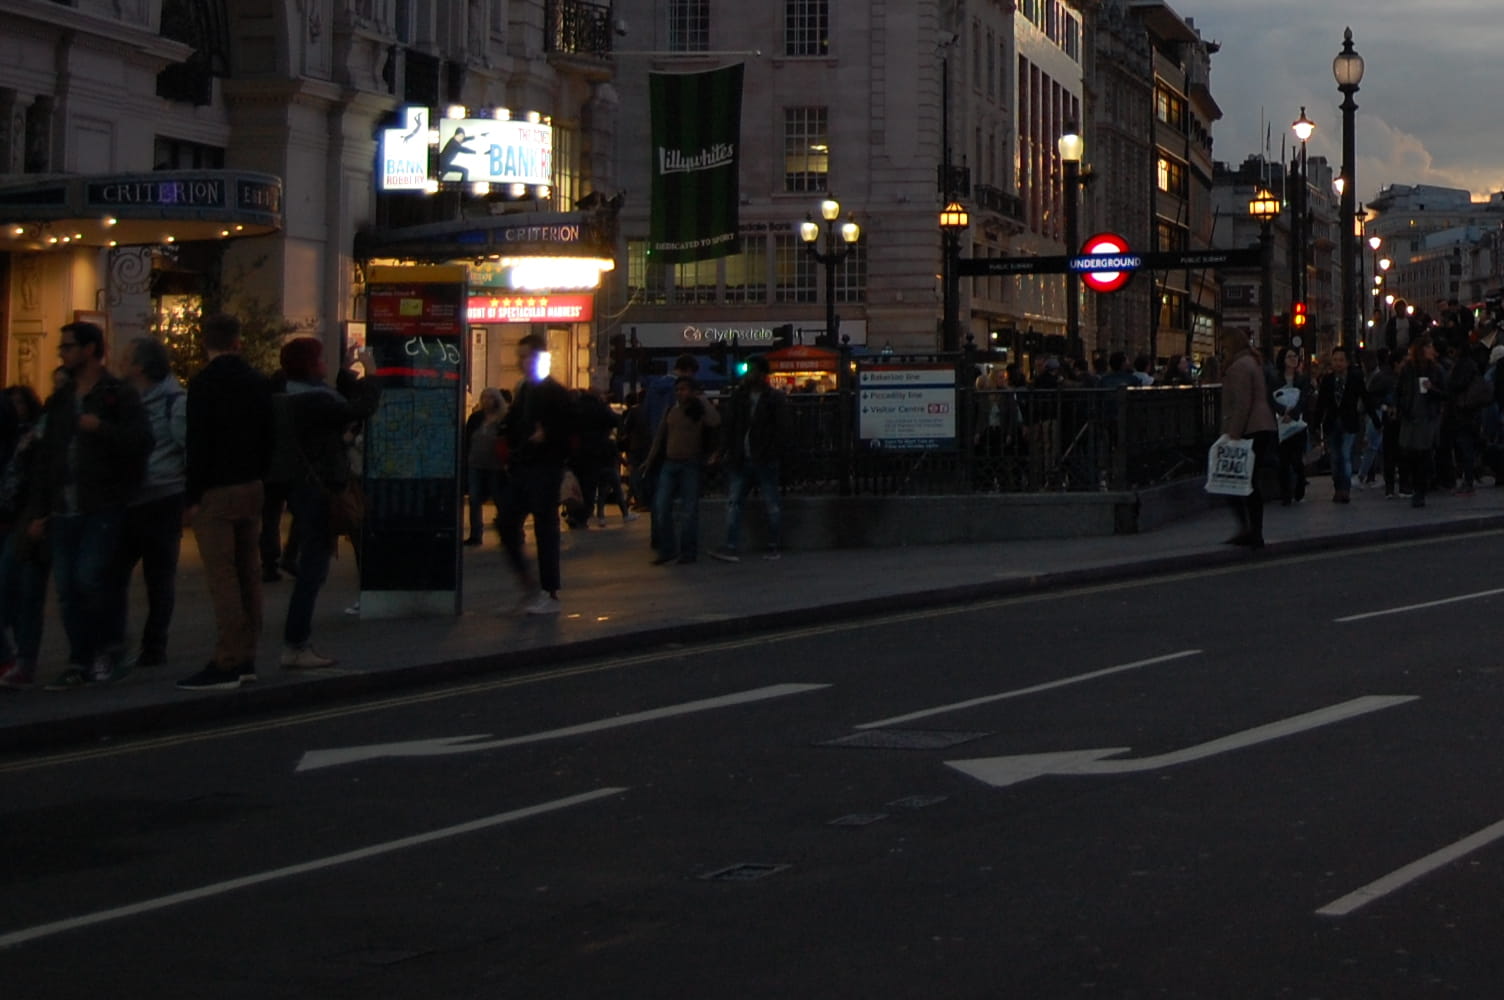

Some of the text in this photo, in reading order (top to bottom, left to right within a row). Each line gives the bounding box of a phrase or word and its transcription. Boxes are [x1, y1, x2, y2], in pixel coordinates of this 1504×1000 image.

[386, 160, 424, 175] BANK
[489, 143, 538, 177] BANK
[659, 142, 735, 175] Lillywhites
[103, 181, 220, 204] CRITERION
[504, 223, 580, 242] CRITERION
[655, 240, 699, 251] DEDICATED
[700, 238, 712, 247] TO
[1069, 256, 1142, 270] UNDERGROUND
